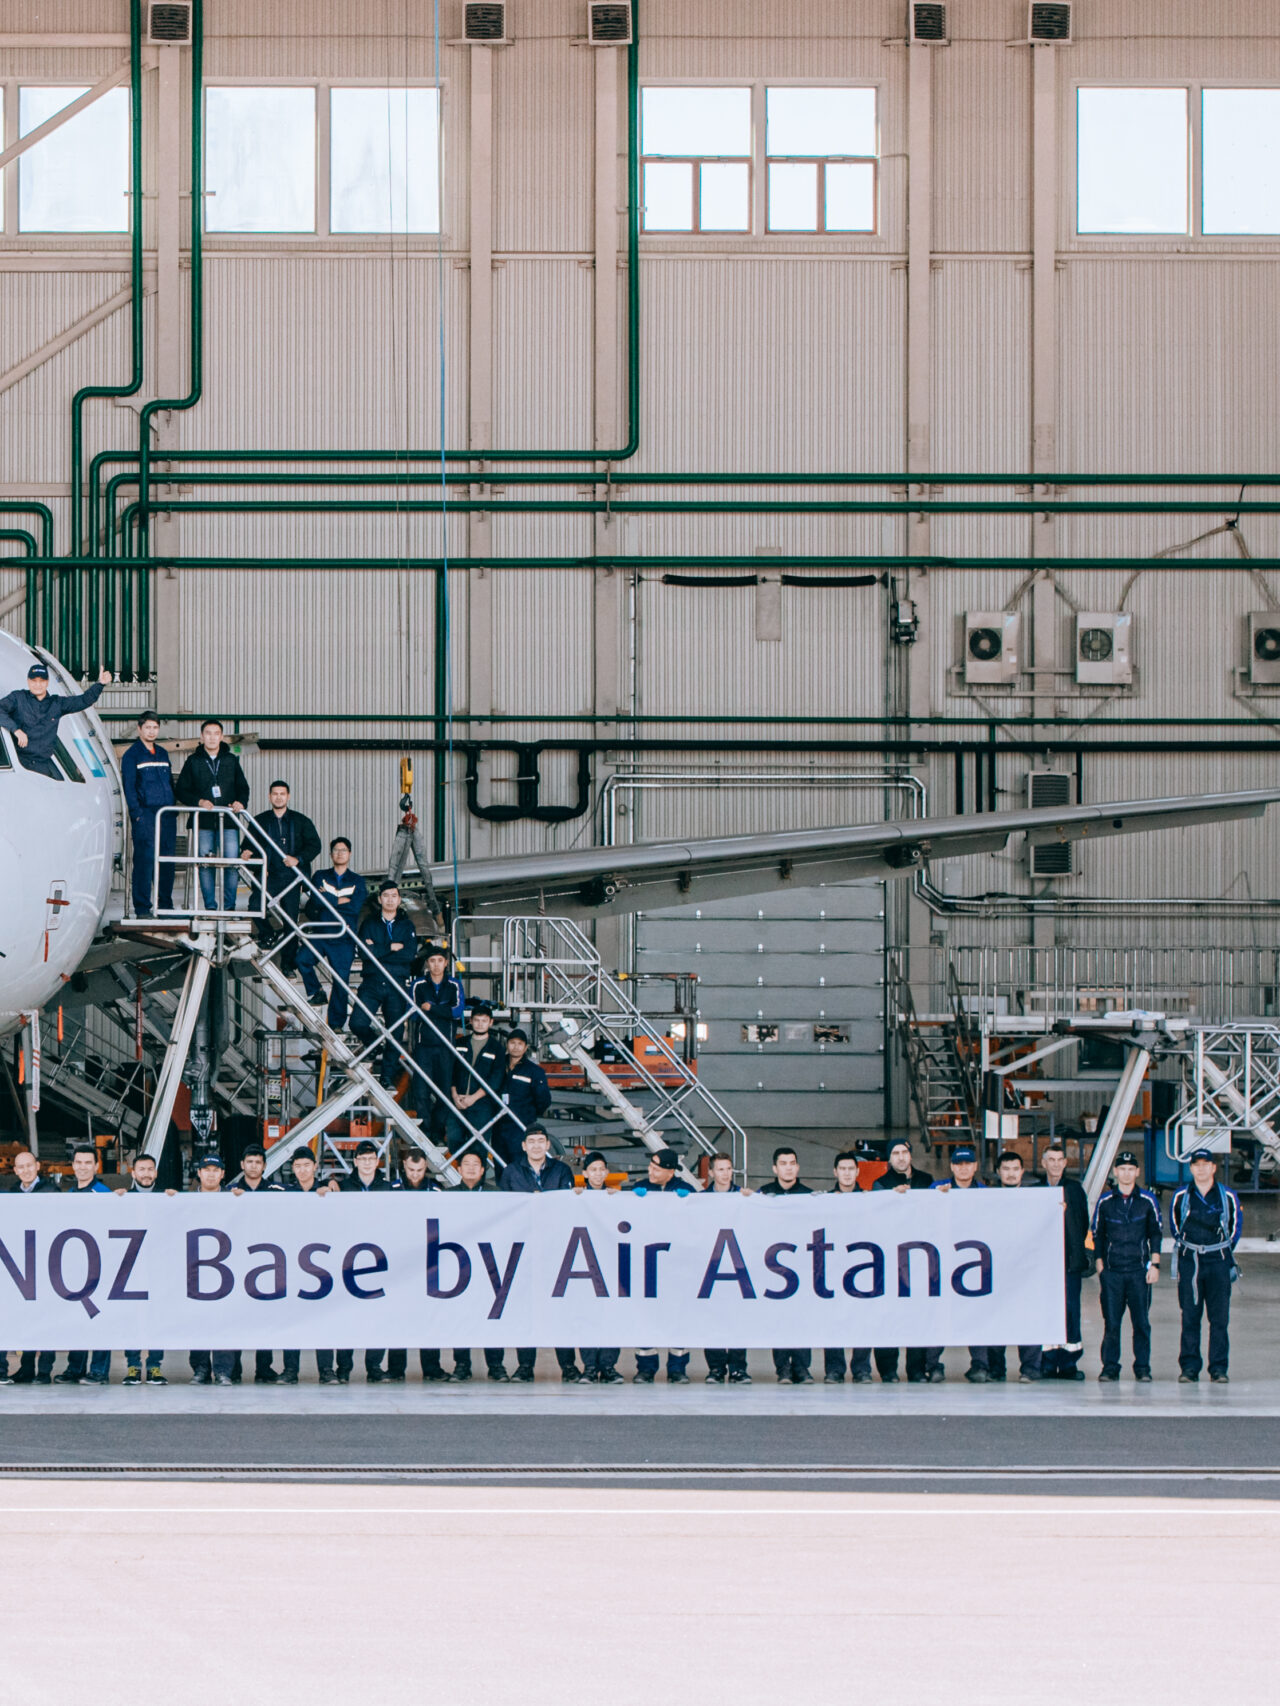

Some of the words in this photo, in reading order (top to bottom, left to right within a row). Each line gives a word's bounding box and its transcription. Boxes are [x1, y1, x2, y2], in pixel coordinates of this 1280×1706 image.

[186, 1228, 389, 1301] Base
[425, 1218, 524, 1319] by
[551, 1220, 671, 1299] Air
[696, 1227, 993, 1299] Astana
